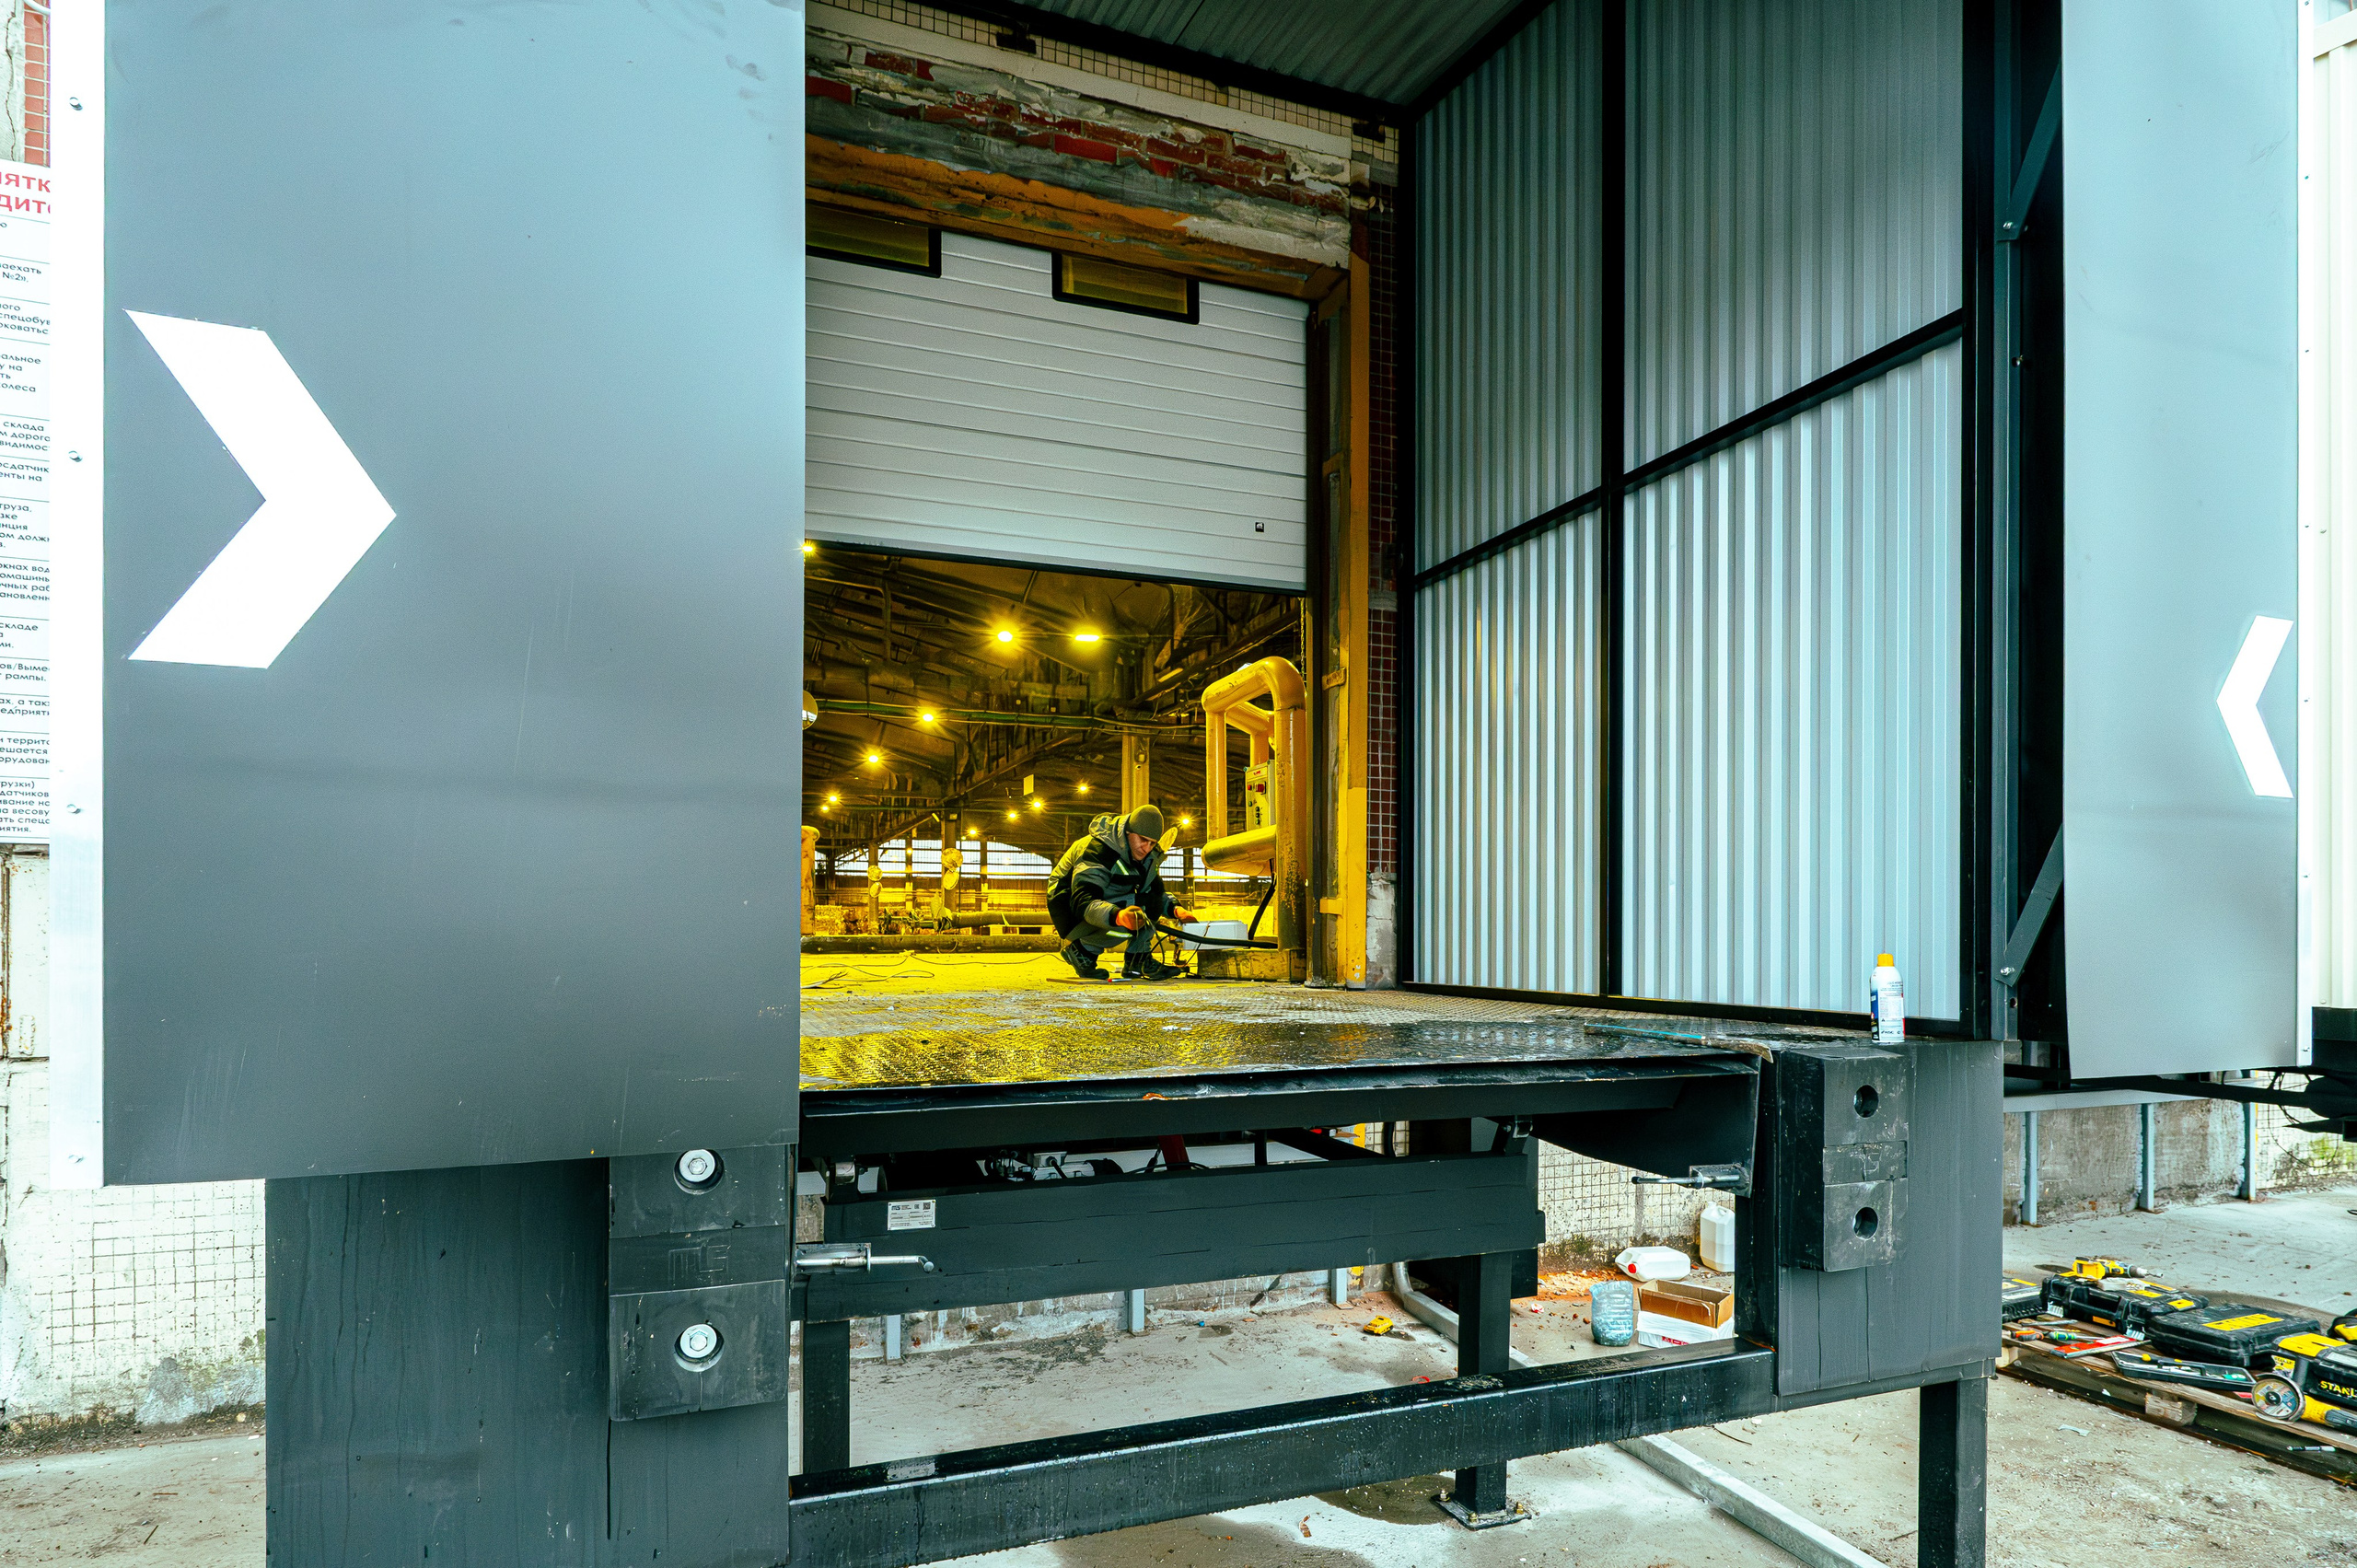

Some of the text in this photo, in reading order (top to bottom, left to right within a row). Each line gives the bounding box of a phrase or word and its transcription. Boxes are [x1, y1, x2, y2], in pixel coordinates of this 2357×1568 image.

[0, 172, 51, 192] ЯТК
[0, 194, 51, 214] ДИТ
[0, 263, 41, 274] аехать
[0, 354, 41, 365] альное
[0, 382, 36, 392] олеса
[3, 422, 44, 432] склада
[0, 440, 50, 451] видимос
[0, 462, 50, 473] сдатчик
[0, 663, 50, 672] ов/Выме
[6, 673, 46, 681] рампы.
[0, 781, 35, 789] рузки)
[2320, 1380, 2357, 1398] STANL
